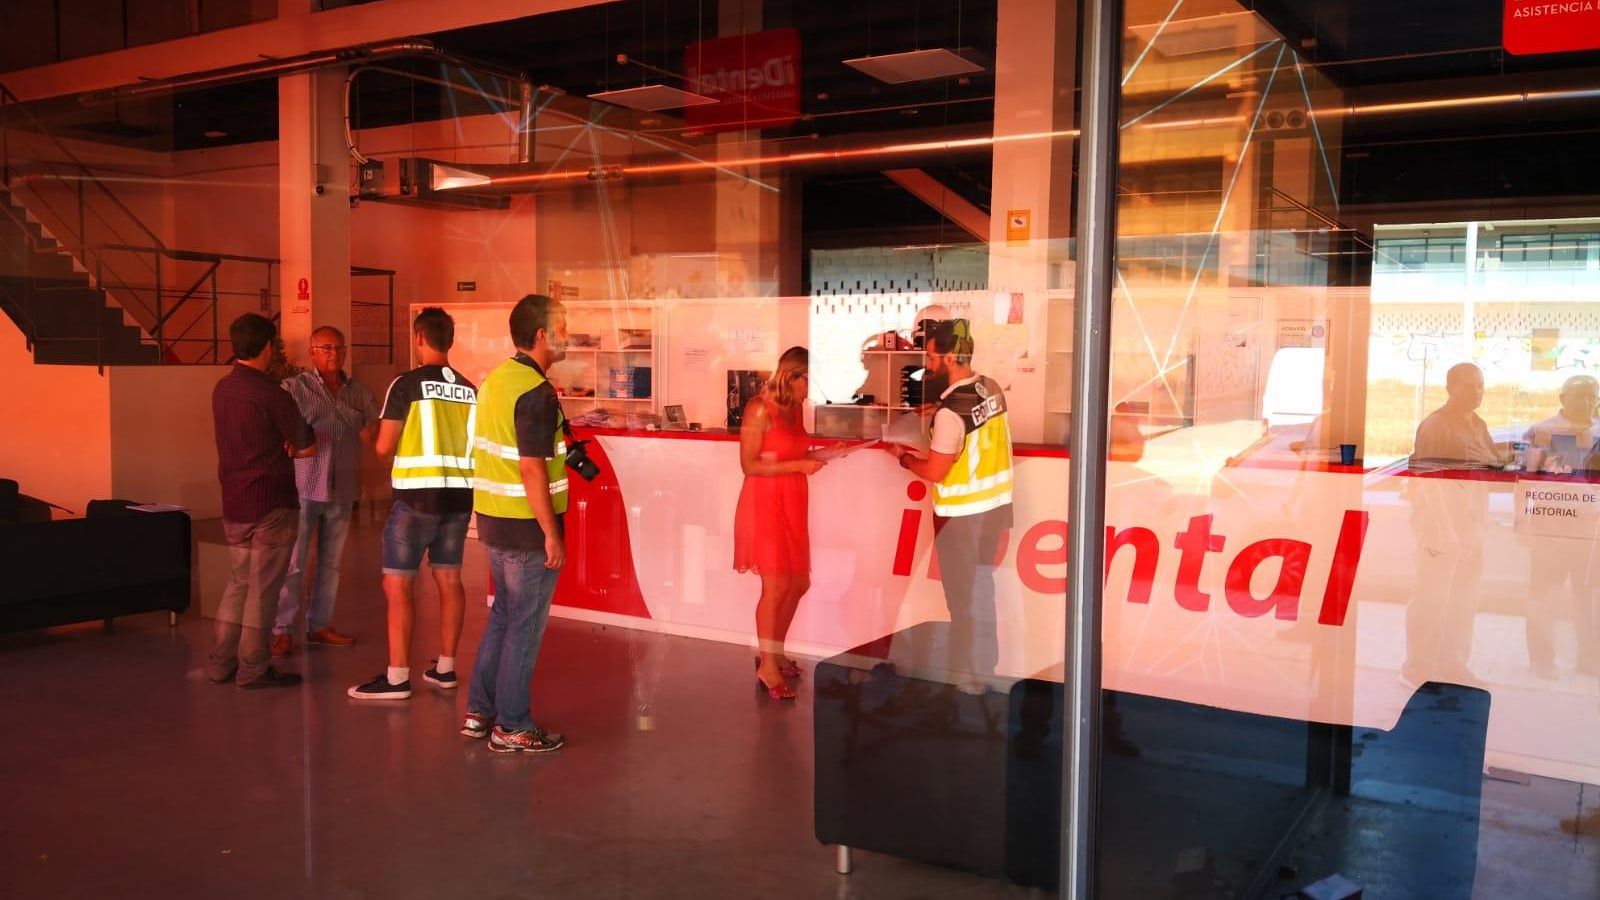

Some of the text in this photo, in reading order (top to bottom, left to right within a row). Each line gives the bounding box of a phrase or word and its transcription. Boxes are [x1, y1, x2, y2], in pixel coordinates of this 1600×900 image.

[1513, 1, 1593, 18] ASISTENCIA
[424, 383, 476, 402] POLICIA
[1525, 490, 1596, 502] RECOGIDA DE
[1525, 506, 1578, 518] HISTORIAL
